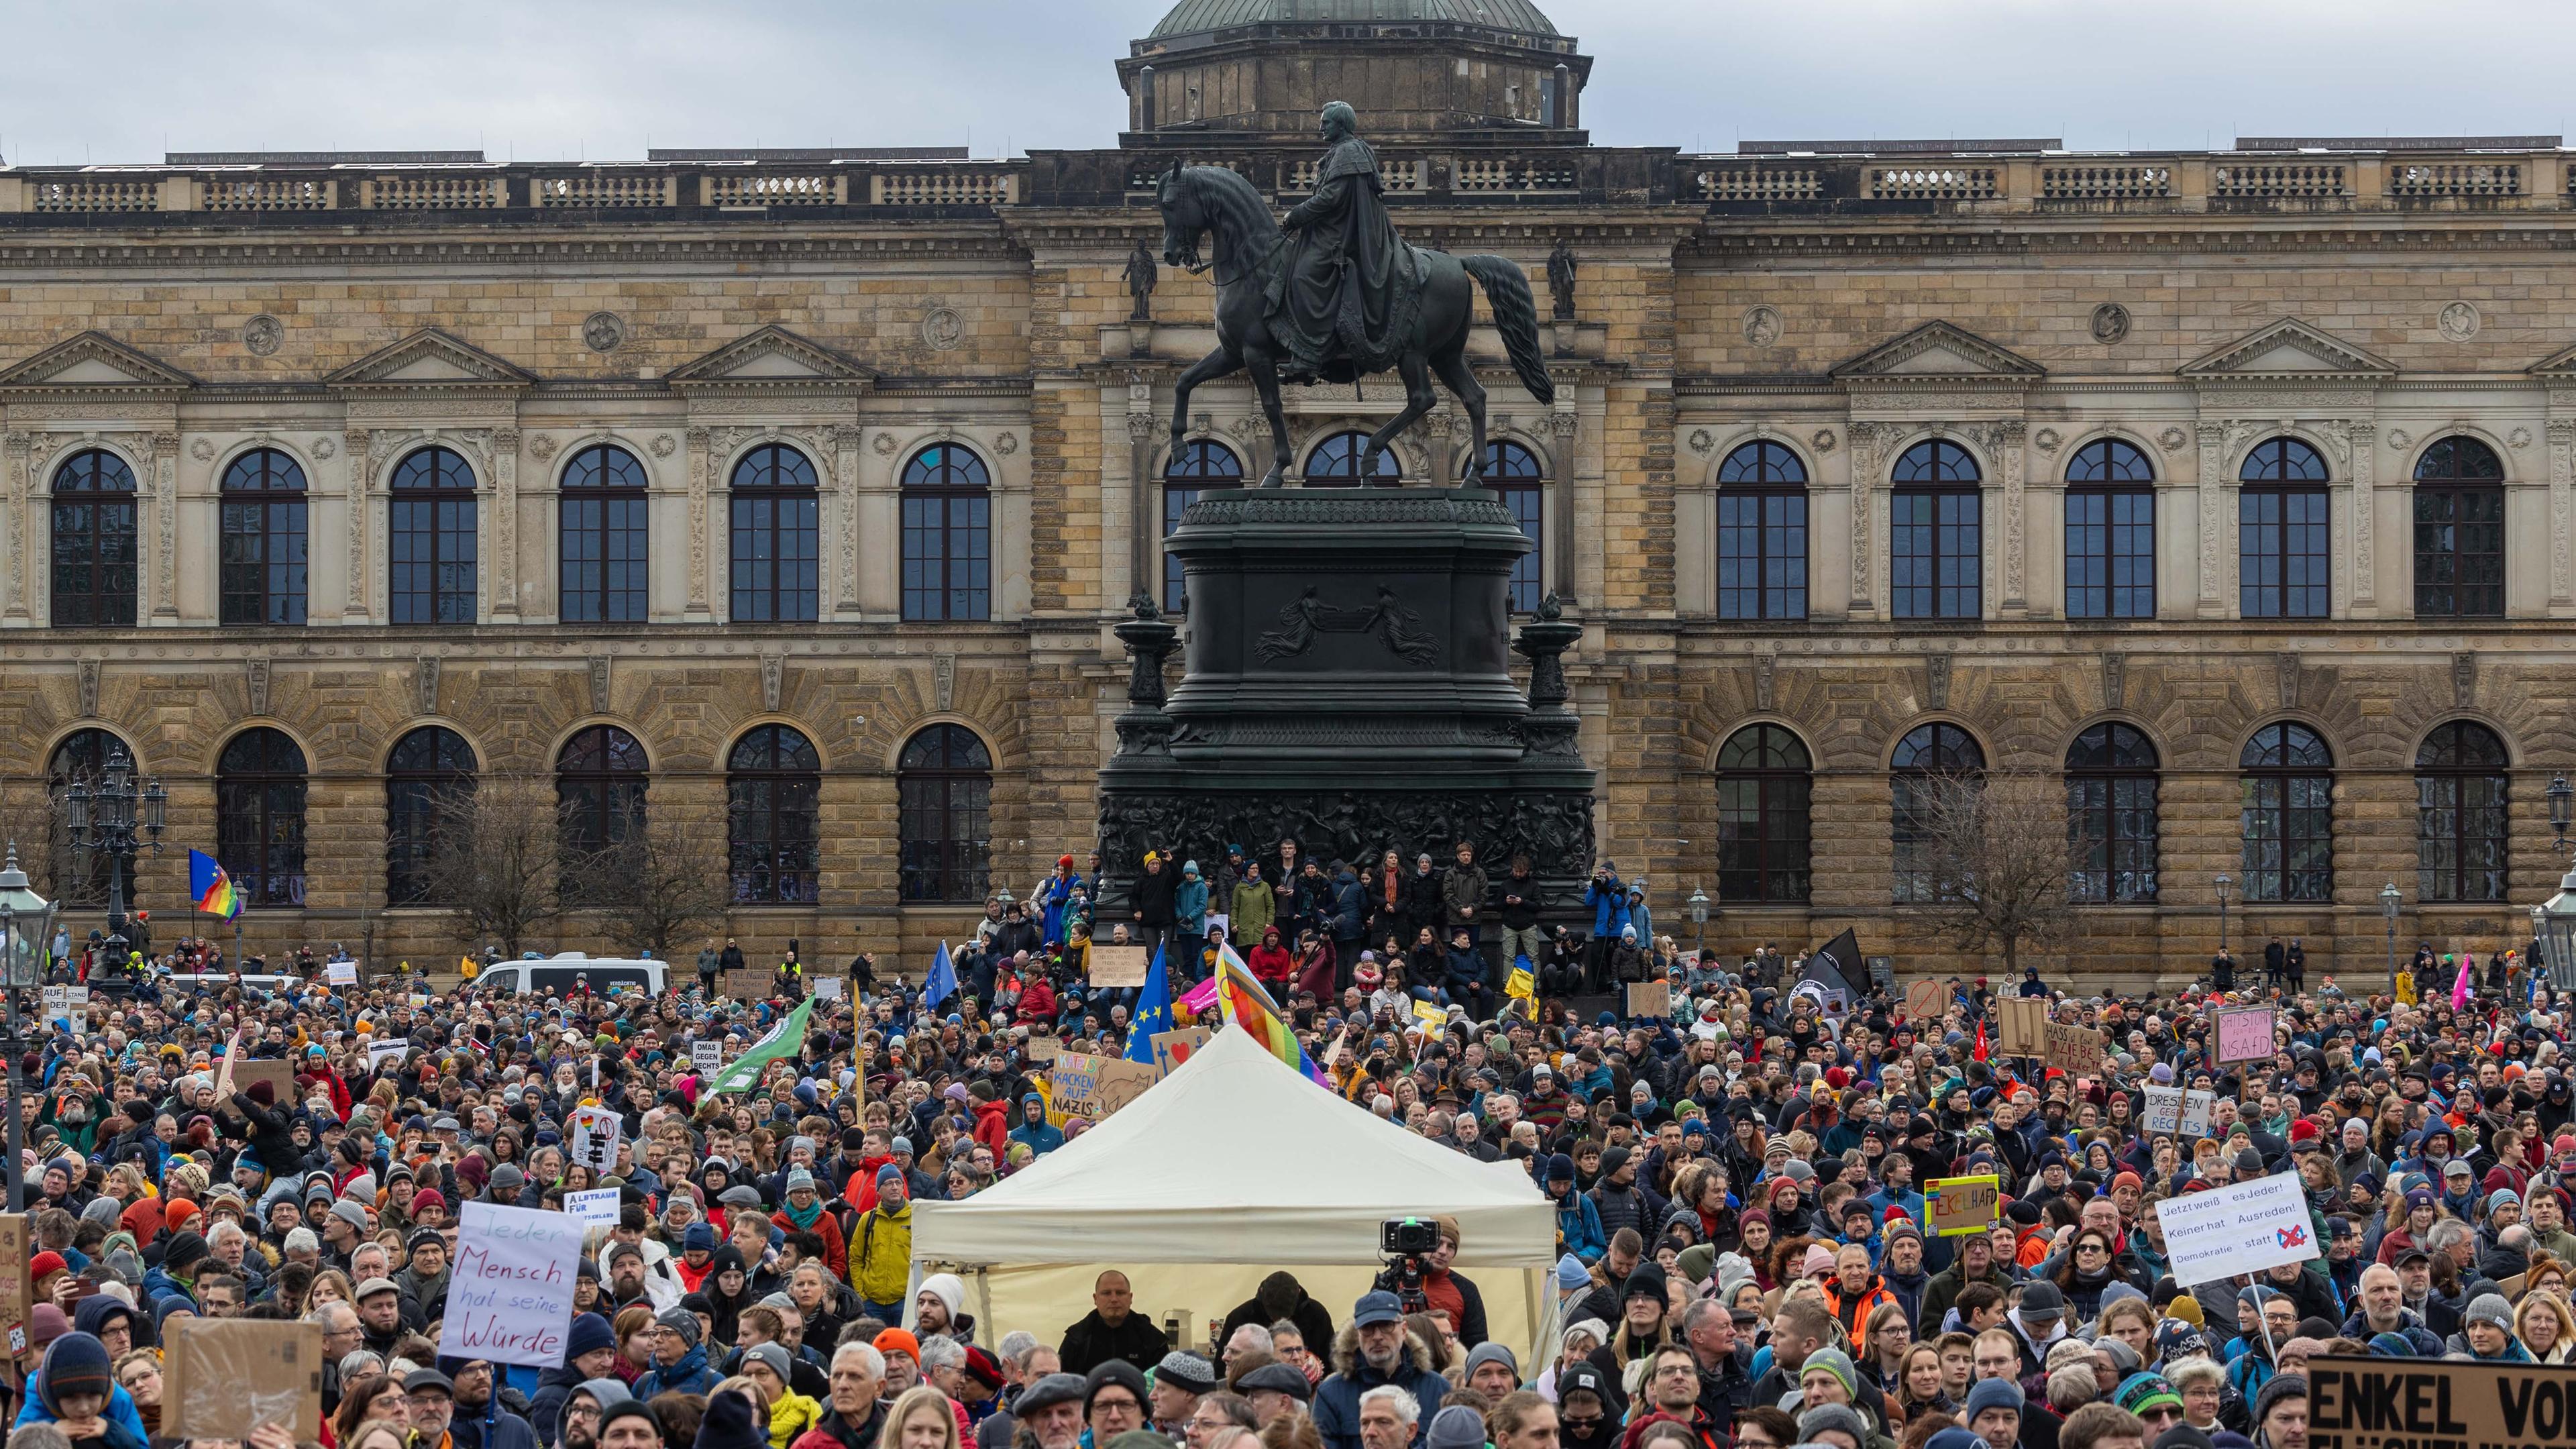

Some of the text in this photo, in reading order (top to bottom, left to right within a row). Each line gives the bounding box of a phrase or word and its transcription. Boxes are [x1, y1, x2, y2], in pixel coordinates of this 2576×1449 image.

[44, 989, 62, 997] AUF
[2220, 1010, 2271, 1028] SHITSTORM
[2045, 1024, 2068, 1041] HASS
[2059, 1042, 2094, 1060] LIEBE
[2221, 1036, 2269, 1058] NSAfD
[1054, 1071, 1095, 1089] KACKEN
[1063, 1086, 1090, 1100] AUF
[1052, 1097, 1094, 1117] NAZIS
[570, 1191, 617, 1204] ALBTRAUM
[2163, 1183, 2284, 1217] Jetzt weiß es Jeder!
[569, 1203, 587, 1214] FÜR
[480, 1210, 565, 1242] Jeder
[2168, 1203, 2296, 1239] Keiner hat Ausreden!
[2176, 1245, 2233, 1264] Demokratie
[2245, 1234, 2272, 1248] statt
[455, 1244, 561, 1284] Mensch
[460, 1283, 559, 1314] hat seine
[9, 1325, 25, 1340] FCK
[462, 1311, 559, 1354] Würde
[11, 1336, 27, 1352] AFD
[2309, 1370, 2467, 1436] ENKEL
